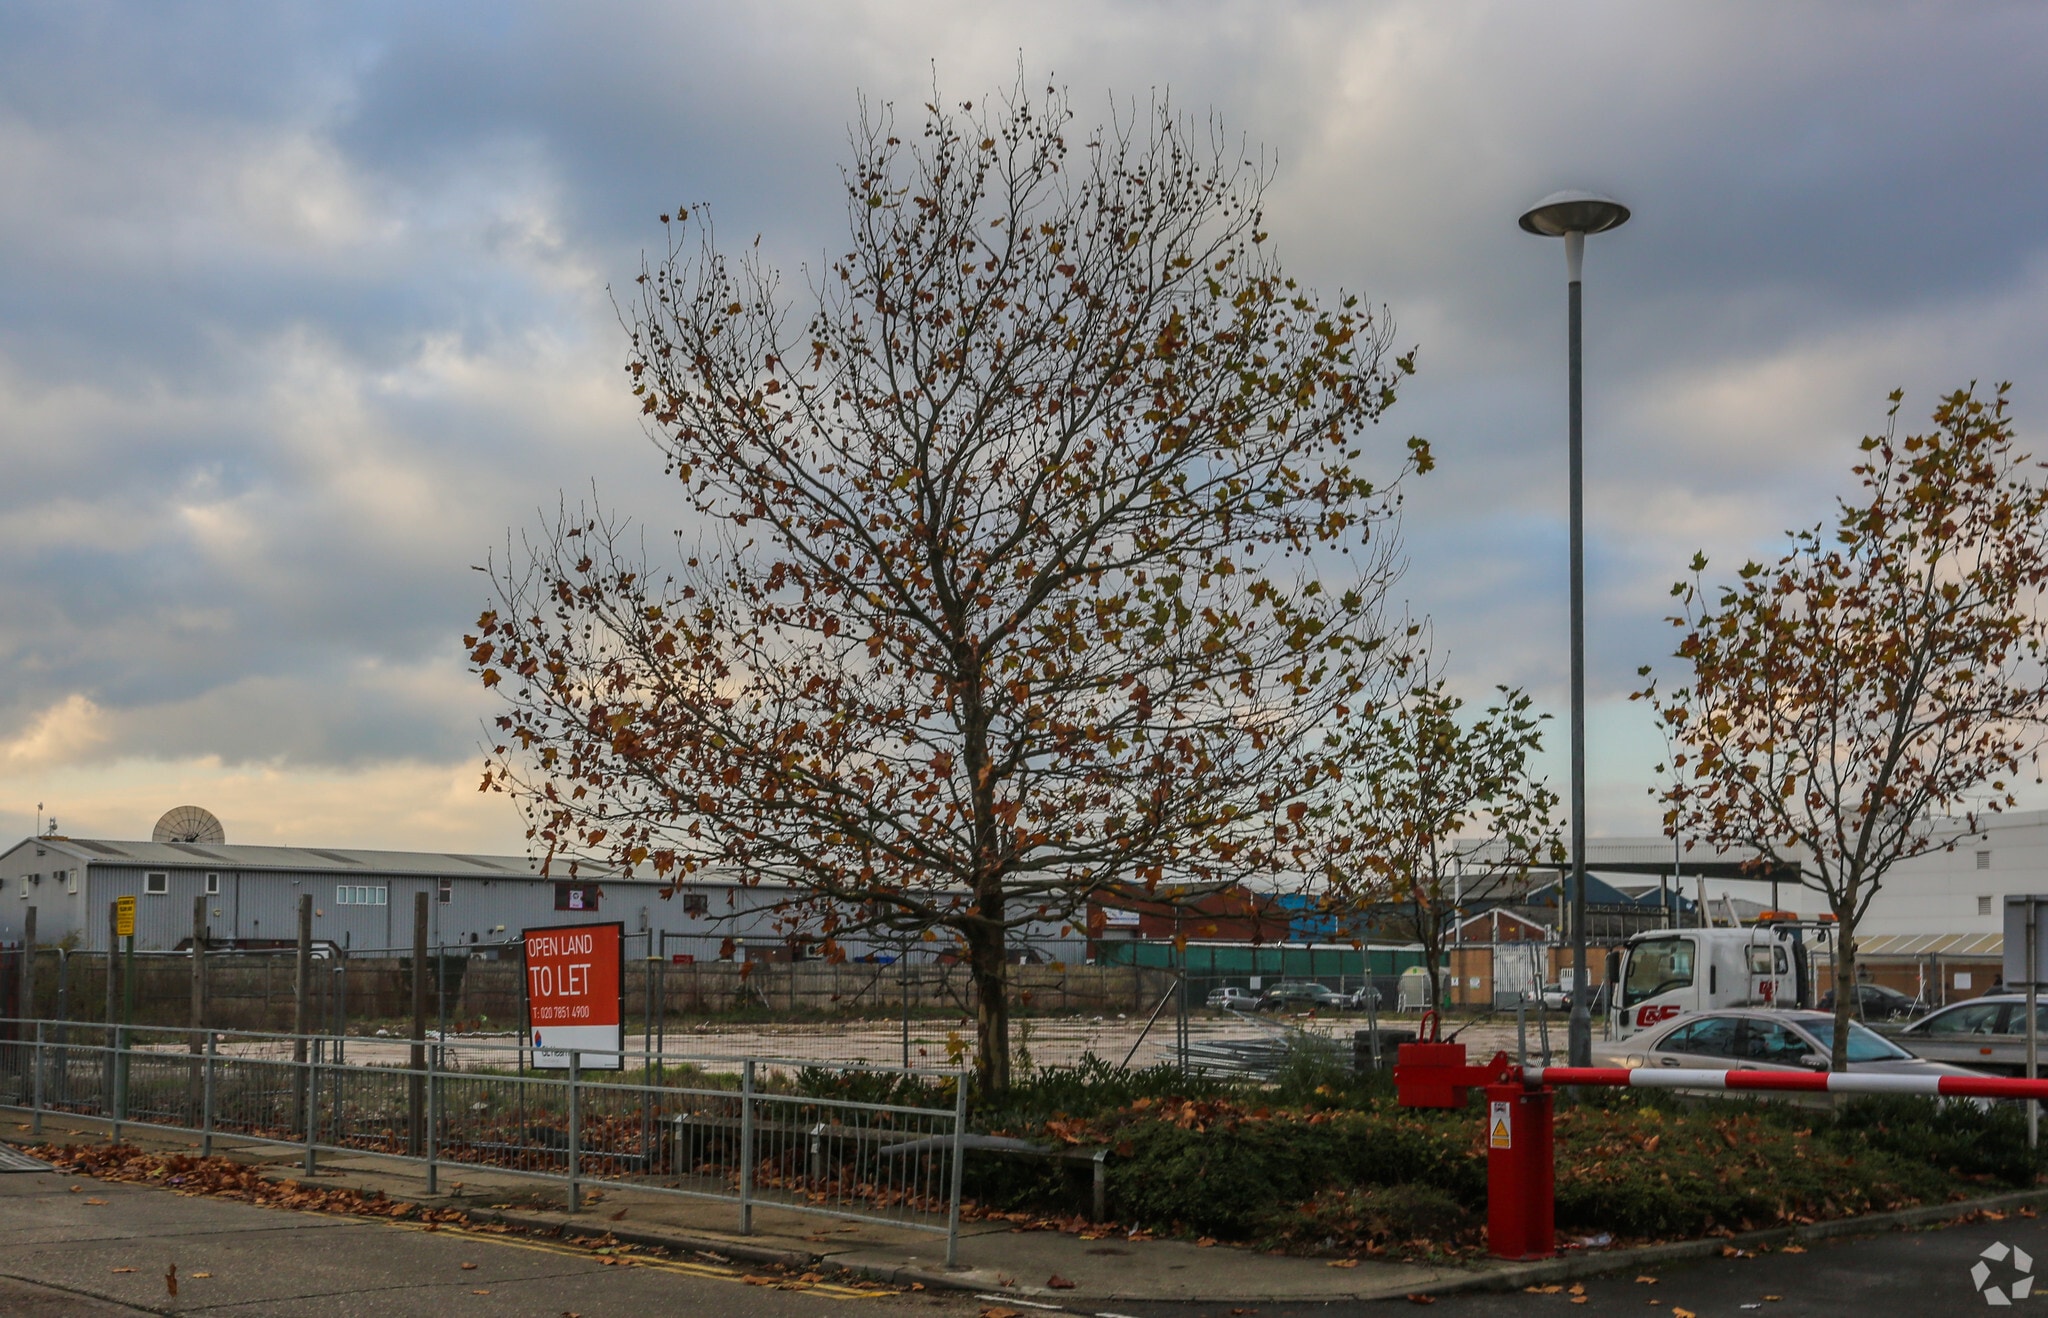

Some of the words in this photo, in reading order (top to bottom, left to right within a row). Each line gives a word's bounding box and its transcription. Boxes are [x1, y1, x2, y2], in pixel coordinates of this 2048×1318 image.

[528, 937, 558, 958] OPEN
[561, 934, 593, 955] LAND
[529, 966, 552, 997] TO
[558, 963, 591, 996] LET
[532, 1006, 540, 1019] T:
[540, 1006, 553, 1019] 020
[553, 1005, 570, 1018] 7851
[571, 1005, 590, 1018] 4900
